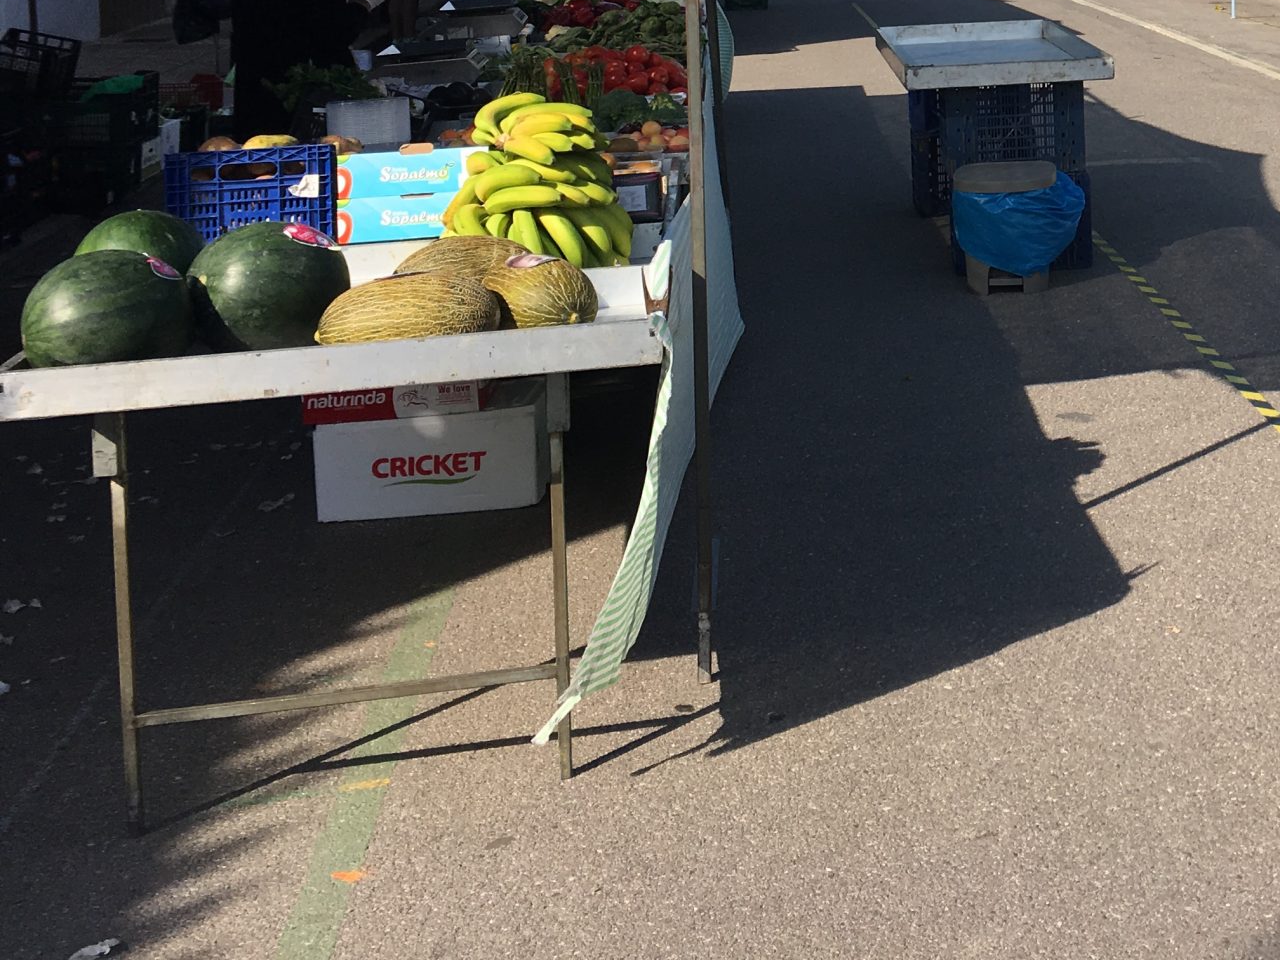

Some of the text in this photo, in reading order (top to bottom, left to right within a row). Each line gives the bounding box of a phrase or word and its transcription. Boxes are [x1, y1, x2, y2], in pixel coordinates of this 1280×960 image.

[380, 166, 449, 182] Sopalmo
[437, 383, 471, 394] We love
[306, 391, 386, 410] naturinda
[371, 451, 487, 479] CRICKET
